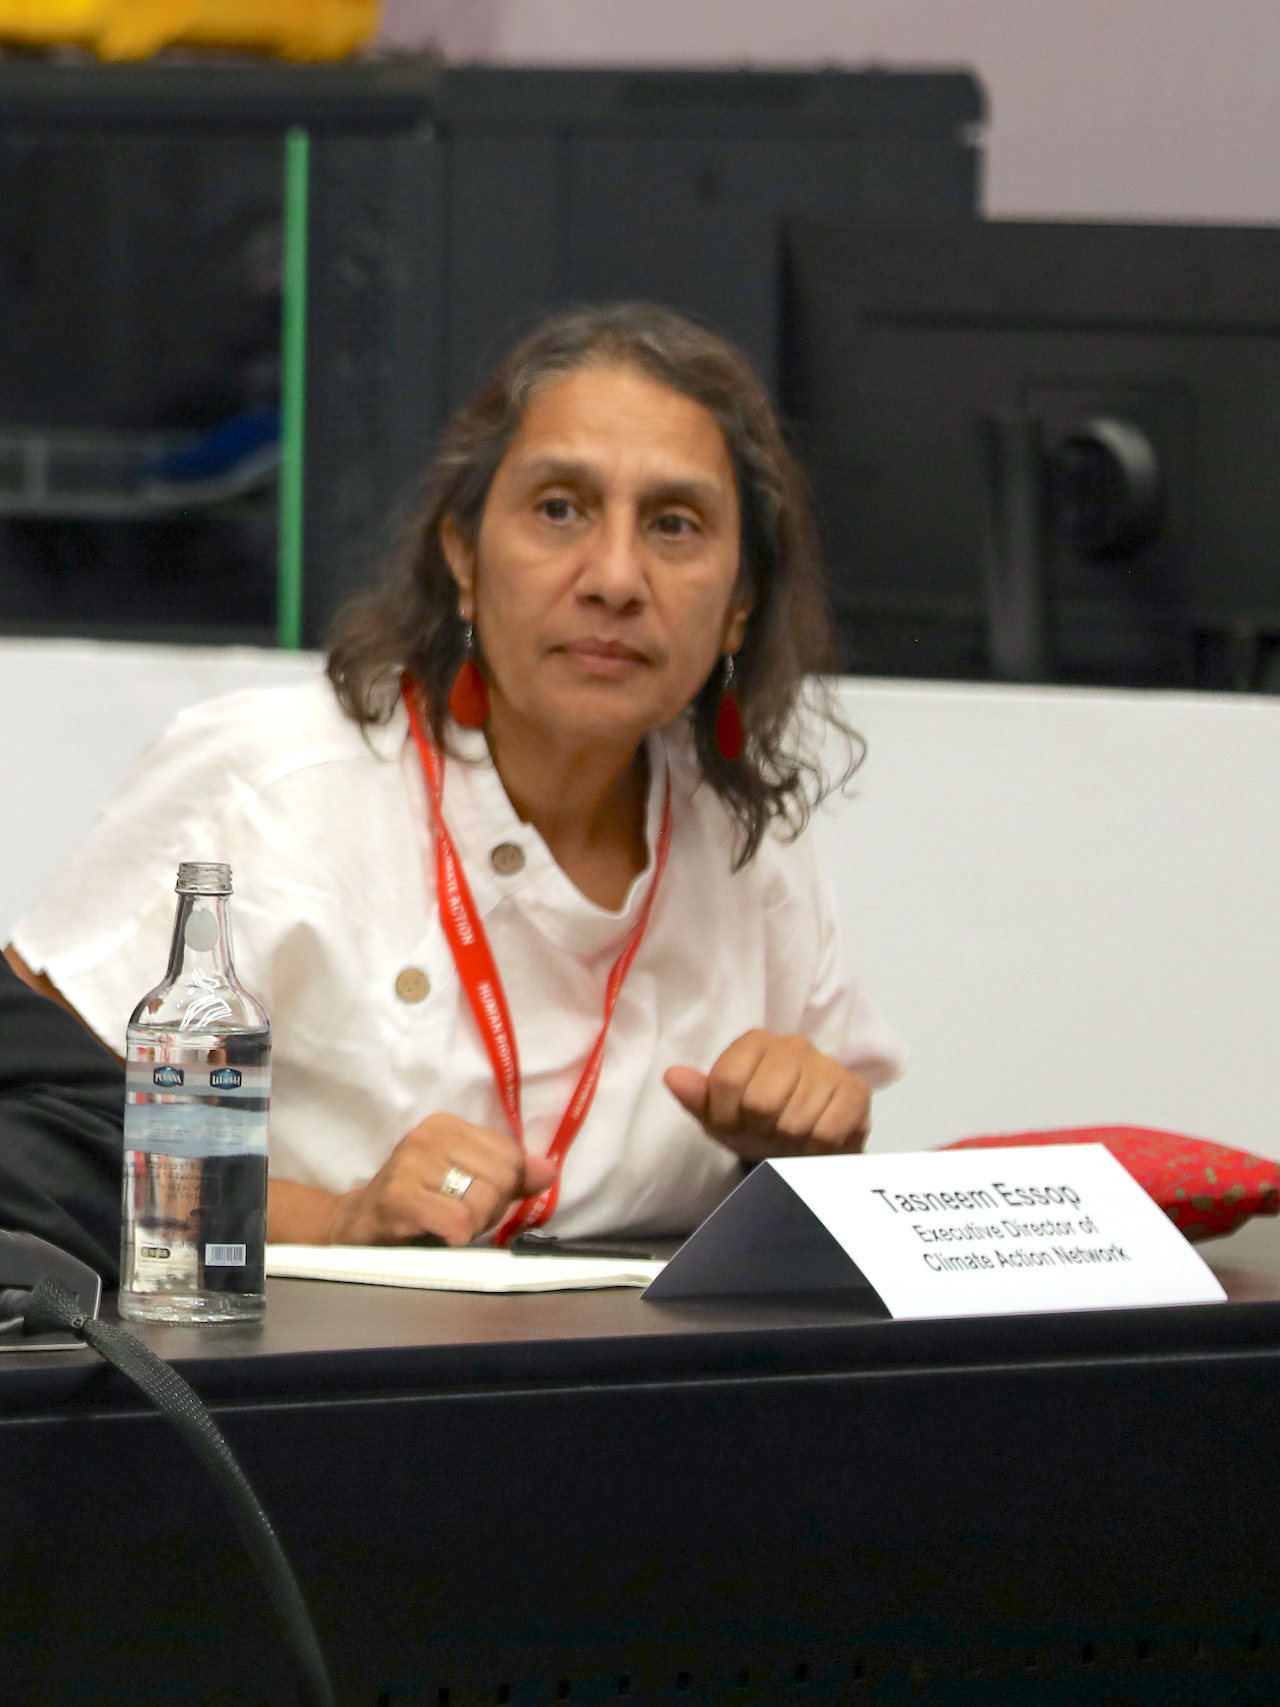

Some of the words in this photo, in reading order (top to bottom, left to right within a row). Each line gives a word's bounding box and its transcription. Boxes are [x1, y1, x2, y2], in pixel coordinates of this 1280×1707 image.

[449, 897, 476, 947] ACTION
[478, 981, 503, 1035] HUMAN
[871, 1188, 1000, 1214] Tasneem
[991, 1182, 1082, 1211] Essop
[912, 1221, 1005, 1244] Executive
[1000, 1217, 1076, 1240] Director
[1077, 1216, 1100, 1235] of
[922, 1248, 995, 1273] Climate
[994, 1246, 1057, 1269] Action
[1051, 1243, 1132, 1266] Network
